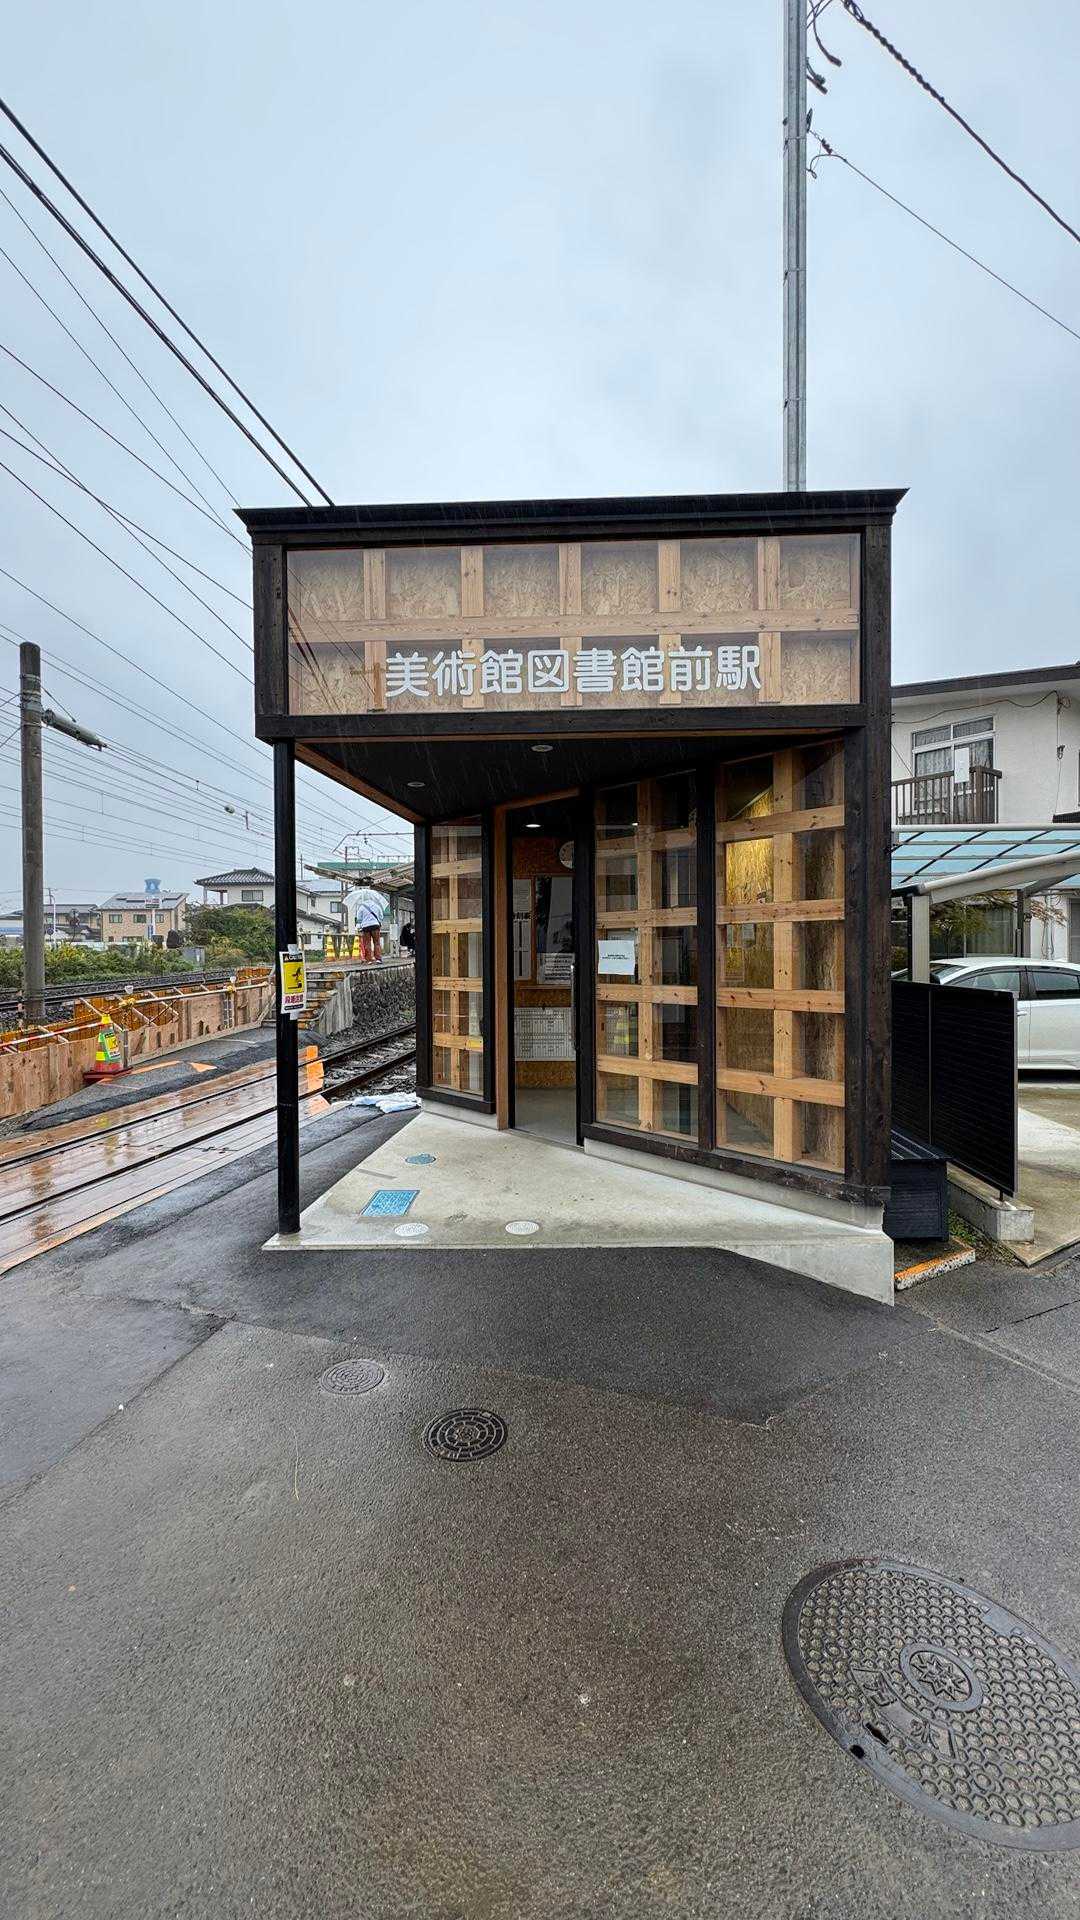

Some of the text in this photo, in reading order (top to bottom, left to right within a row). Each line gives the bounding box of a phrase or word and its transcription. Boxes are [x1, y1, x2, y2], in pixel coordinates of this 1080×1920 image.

[385, 645, 762, 697] 美術館図書館前駅
